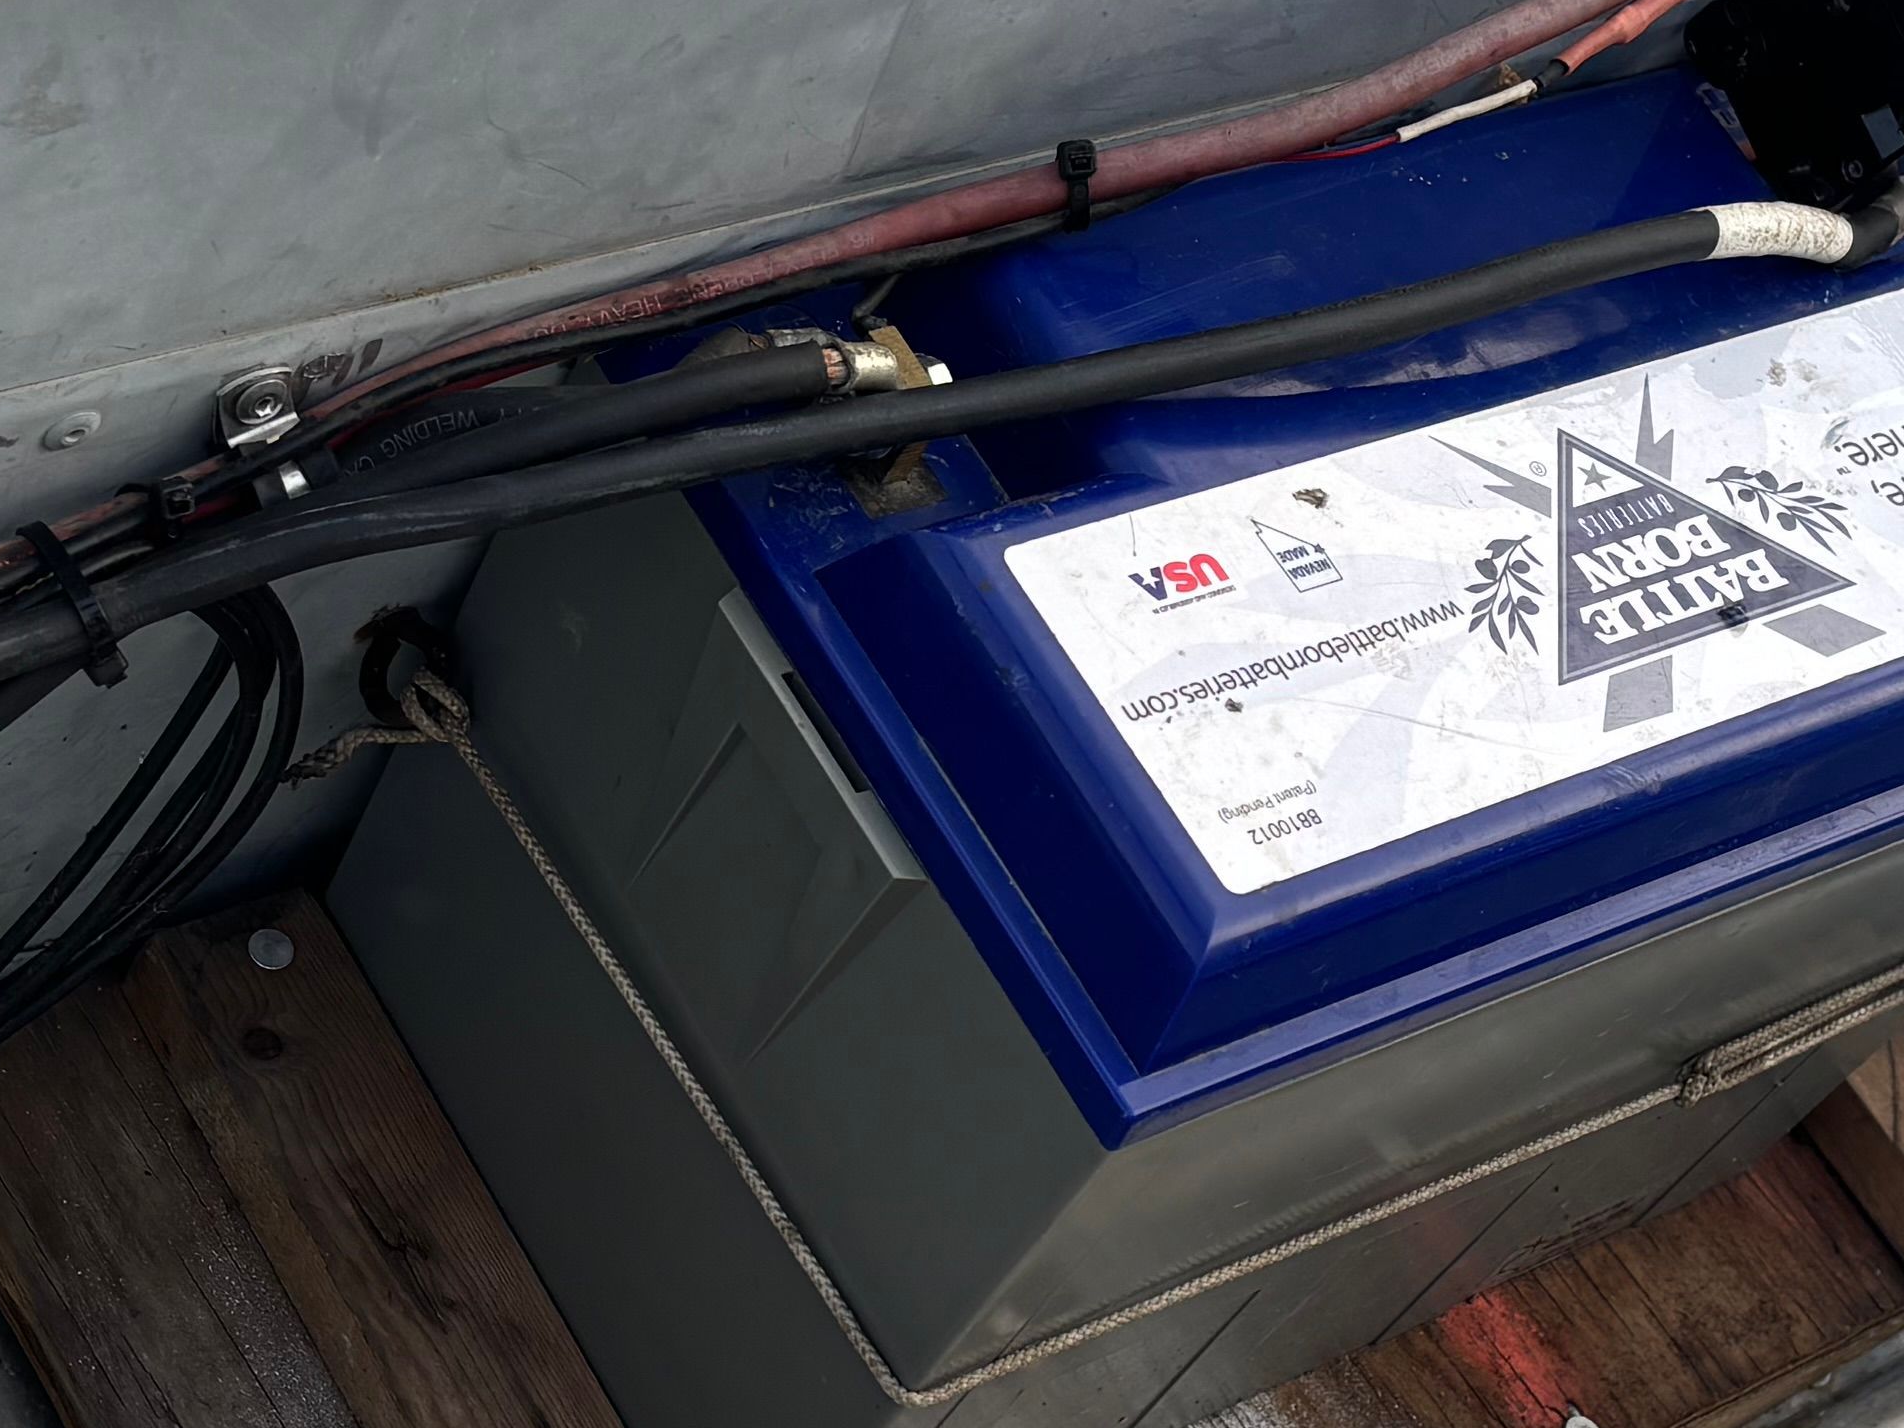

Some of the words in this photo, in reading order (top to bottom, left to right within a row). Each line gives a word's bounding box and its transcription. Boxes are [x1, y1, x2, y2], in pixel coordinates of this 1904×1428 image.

[379, 408, 481, 459] WELDING
[1577, 493, 1675, 538] BATTERIES
[1276, 545, 1310, 563] MADE
[1287, 558, 1332, 580] NEVADA
[1571, 513, 1732, 594] BORN
[1127, 553, 1230, 601] USA
[1578, 548, 1790, 645] BATTLE
[1121, 600, 1465, 722] www.battlebornbatteries.com
[1217, 795, 1275, 825] Pending)
[1272, 779, 1318, 805] (Patent
[1246, 808, 1323, 845] BB10012
